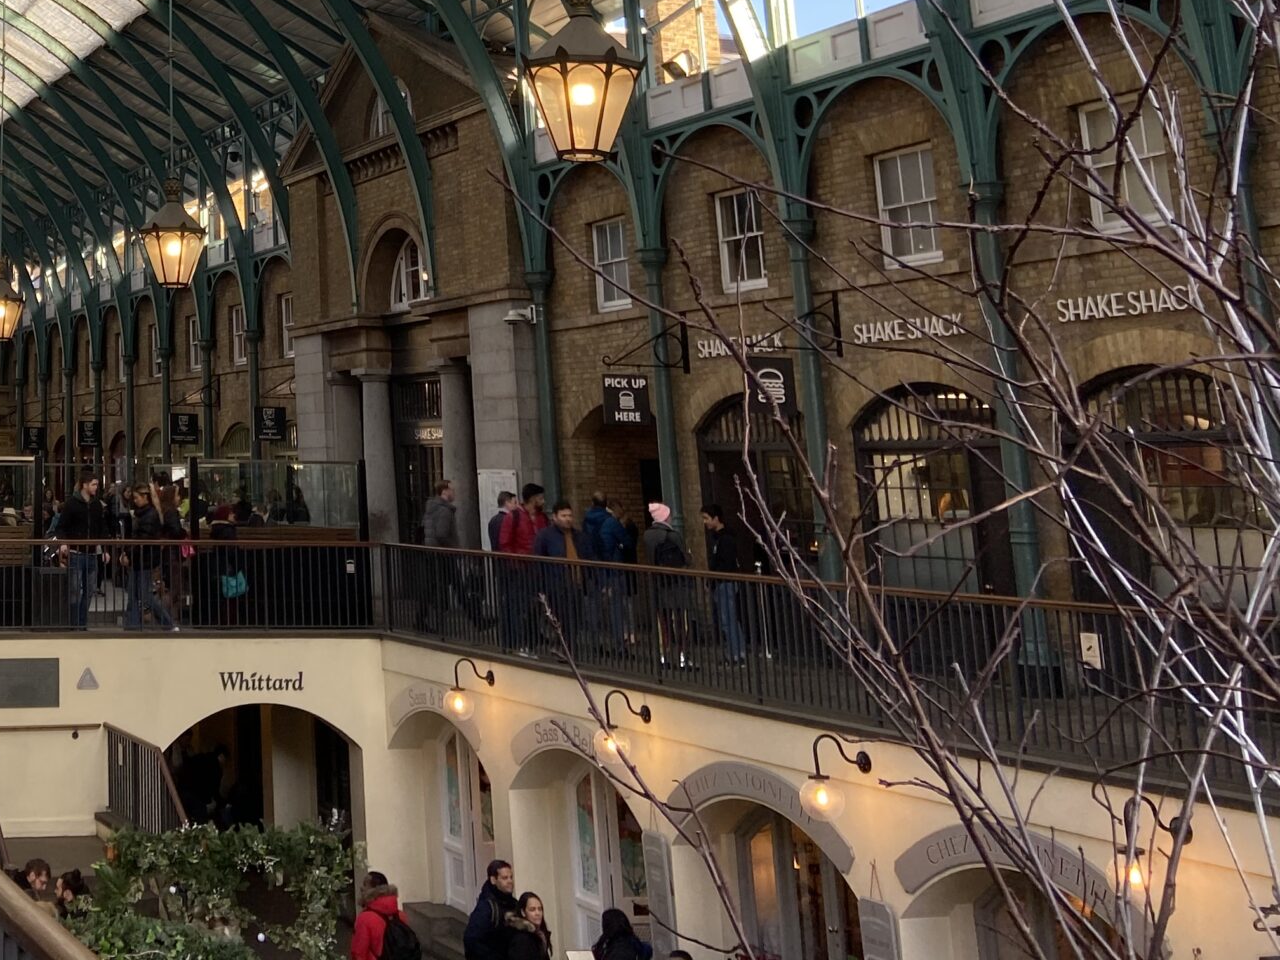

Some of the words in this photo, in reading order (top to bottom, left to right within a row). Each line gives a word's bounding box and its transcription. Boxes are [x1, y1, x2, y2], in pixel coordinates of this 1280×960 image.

[1056, 292, 1126, 323] SHAKE
[853, 320, 906, 344] SHAKE
[906, 313, 966, 339] SHACK
[604, 377, 629, 388] PICK
[631, 377, 647, 389] UP
[615, 411, 641, 423] HERE
[218, 671, 304, 692] Whittard
[534, 723, 558, 744] Sass
[925, 834, 969, 865] CHEZ
